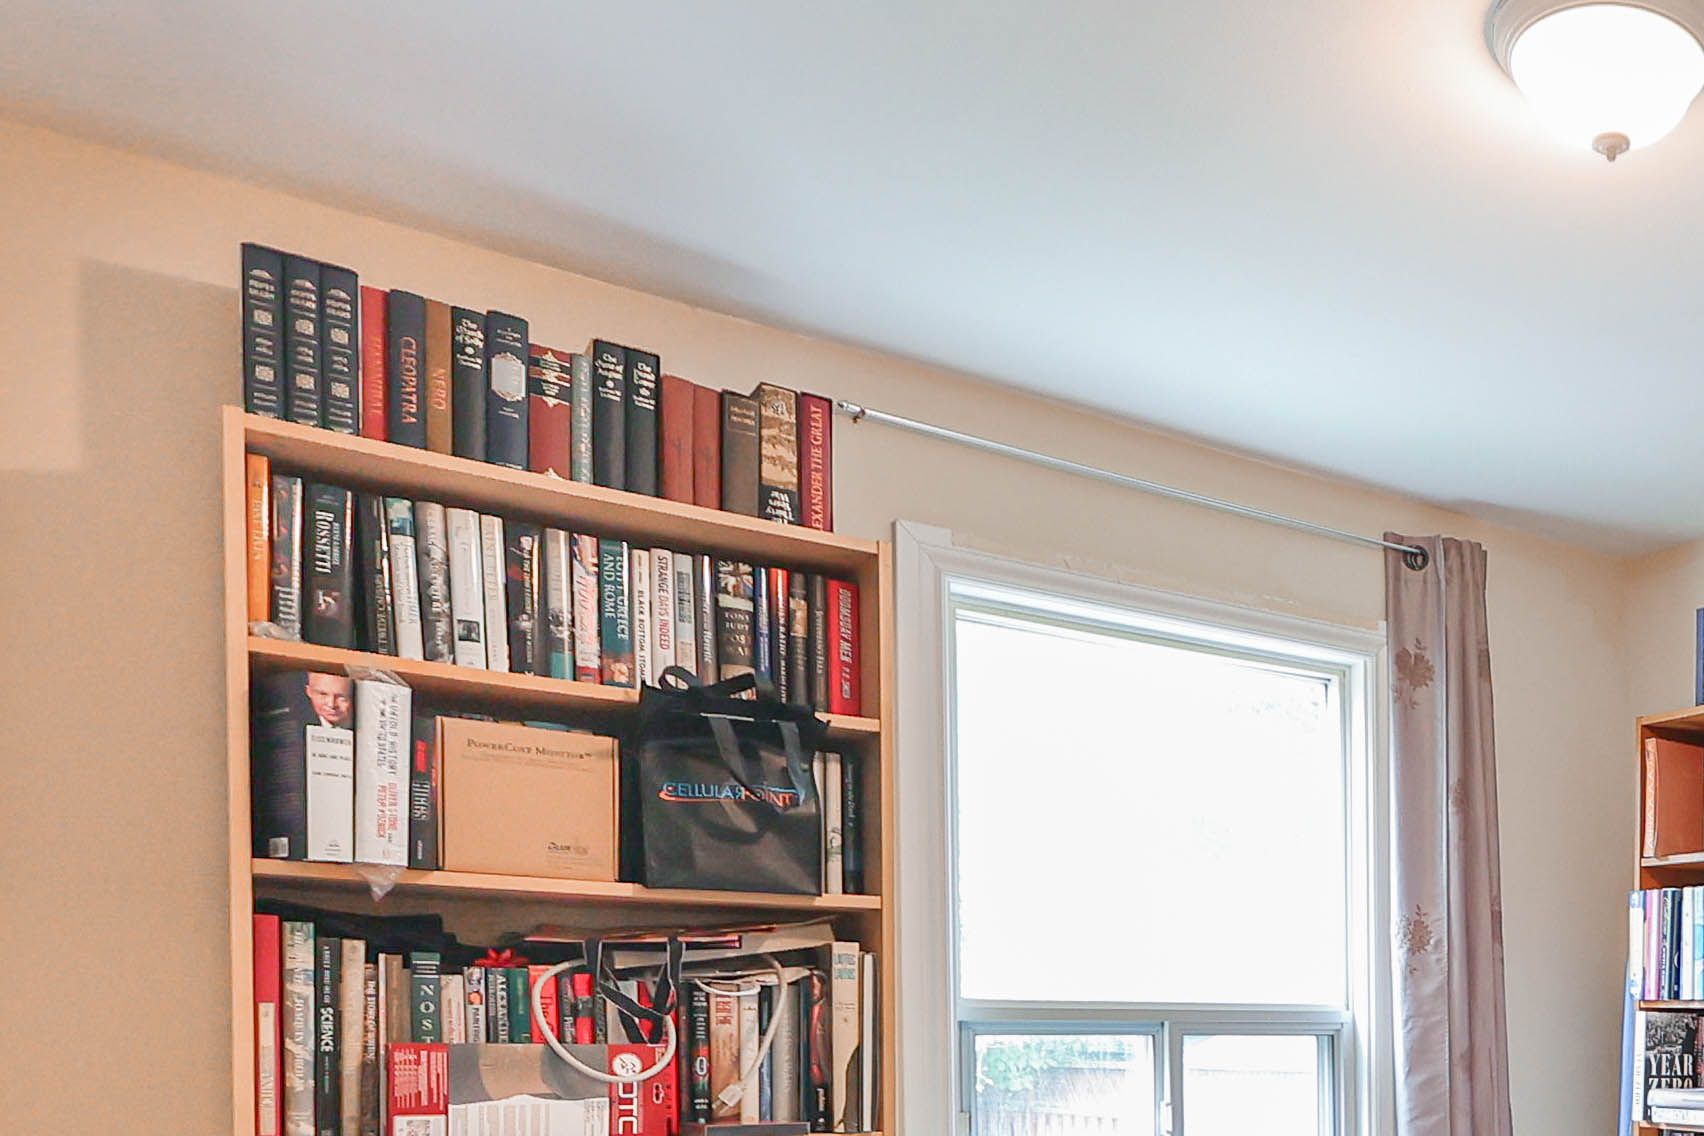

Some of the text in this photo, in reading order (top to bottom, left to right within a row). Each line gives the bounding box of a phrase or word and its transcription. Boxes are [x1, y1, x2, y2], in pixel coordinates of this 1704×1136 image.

[400, 336, 417, 424] CLEOPATRA
[432, 368, 446, 410] NERO
[810, 404, 824, 467] GREAT THE
[314, 511, 335, 574] ROSSETTI
[603, 553, 617, 618] AND ROME
[657, 555, 670, 650] STRANGE DAYS INDEED
[637, 618, 645, 652] BOTTOM
[320, 1007, 335, 1033] SCIENCE
